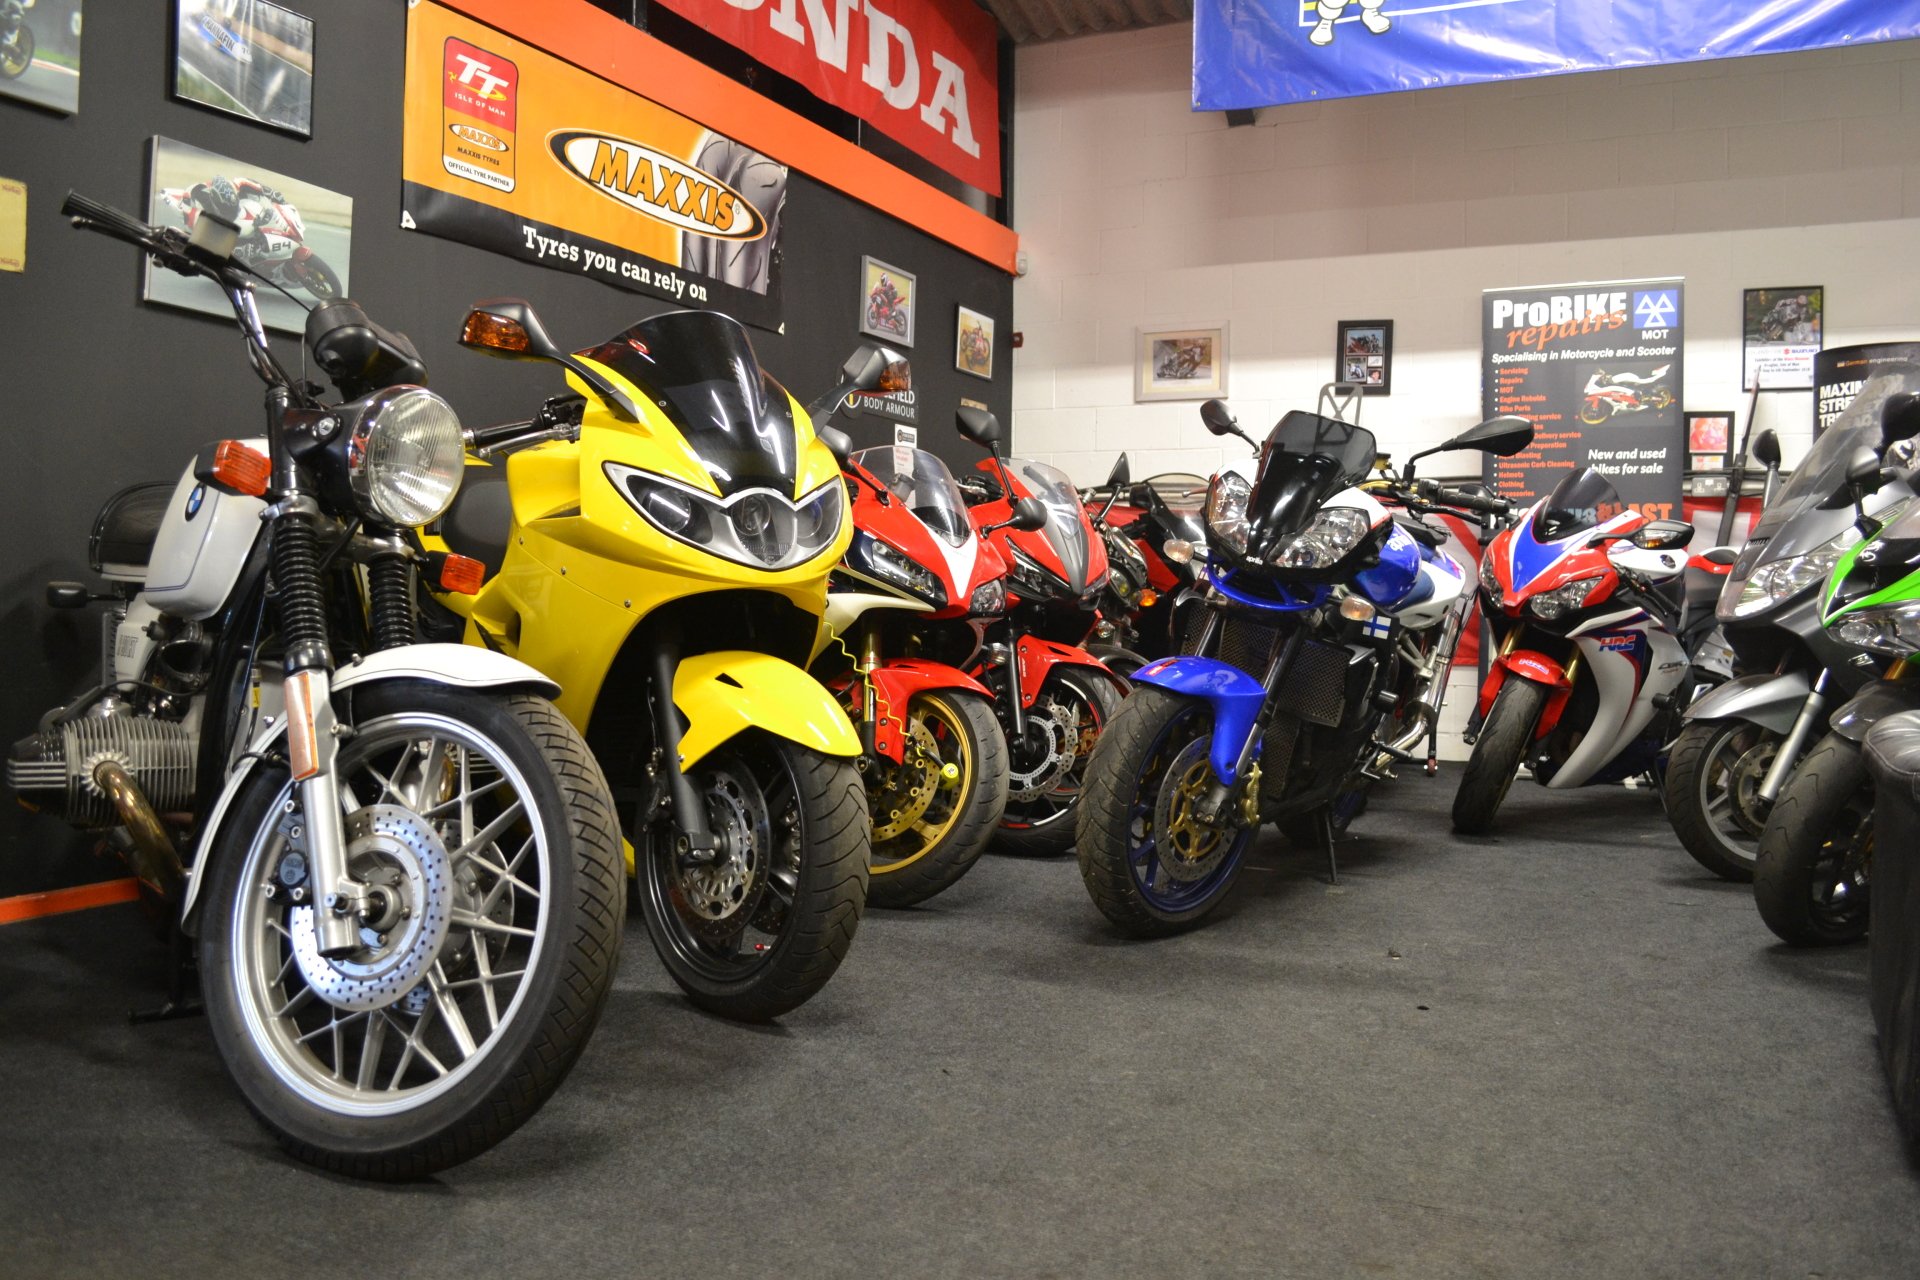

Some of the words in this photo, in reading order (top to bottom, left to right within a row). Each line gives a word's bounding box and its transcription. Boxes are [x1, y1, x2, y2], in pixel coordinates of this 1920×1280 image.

[456, 53, 510, 99] TT
[454, 92, 473, 104] ISLE
[475, 100, 486, 109] OF
[488, 106, 507, 117] MAN
[458, 125, 501, 149] MAXXIS
[457, 146, 482, 160] MAXXIS
[482, 155, 500, 166] TYRES
[448, 161, 473, 174] OFFICIAL
[473, 169, 487, 179] TYRE
[487, 173, 510, 187] PARTNER
[589, 139, 735, 232] MAXXIS
[271, 241, 292, 252] 84
[522, 225, 579, 262] Tyres
[583, 245, 617, 274] you
[621, 261, 651, 284] can
[654, 269, 686, 299] rely
[689, 284, 708, 302] on
[1493, 292, 1628, 329] ProBIKE
[1506, 309, 1626, 351] repairs
[1641, 329, 1670, 341] MOT
[1491, 351, 1548, 364] Specialising
[1549, 351, 1559, 361] in
[1560, 348, 1614, 361] Motorcycle
[1616, 346, 1635, 358] and
[1637, 345, 1677, 357] Scooter
[1868, 356, 1908, 365] engineering
[863, 395, 884, 411] BODY
[885, 402, 915, 419] ARMOUR
[1588, 449, 1614, 460] New
[1615, 448, 1638, 459] and
[1639, 447, 1667, 459] used
[1591, 463, 1620, 475] bikes
[1622, 463, 1638, 475] for
[1640, 462, 1664, 474] sale
[1599, 635, 1637, 651] HRC
